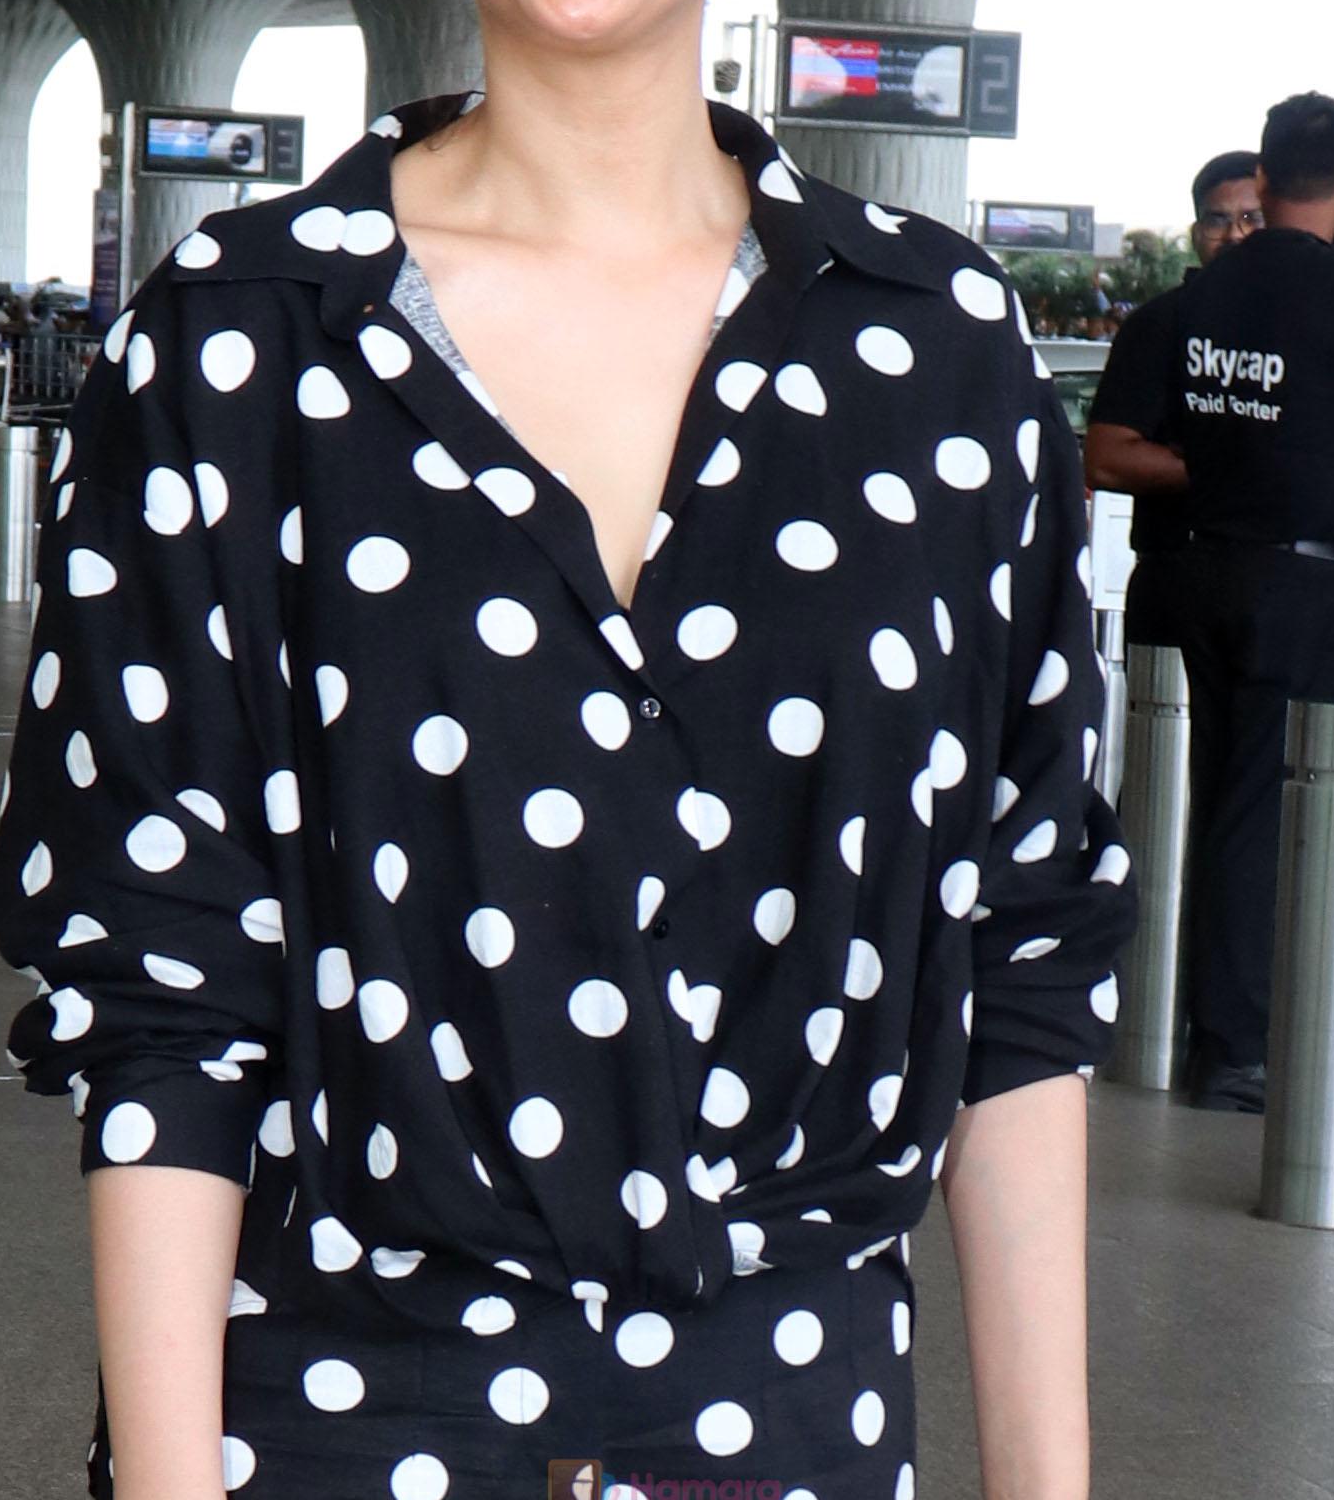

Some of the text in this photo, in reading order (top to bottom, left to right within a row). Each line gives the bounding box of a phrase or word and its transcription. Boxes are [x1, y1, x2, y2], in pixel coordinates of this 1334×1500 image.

[981, 54, 1009, 115] 2
[1187, 337, 1285, 392] Skycap
[1185, 392, 1225, 414] Paid
